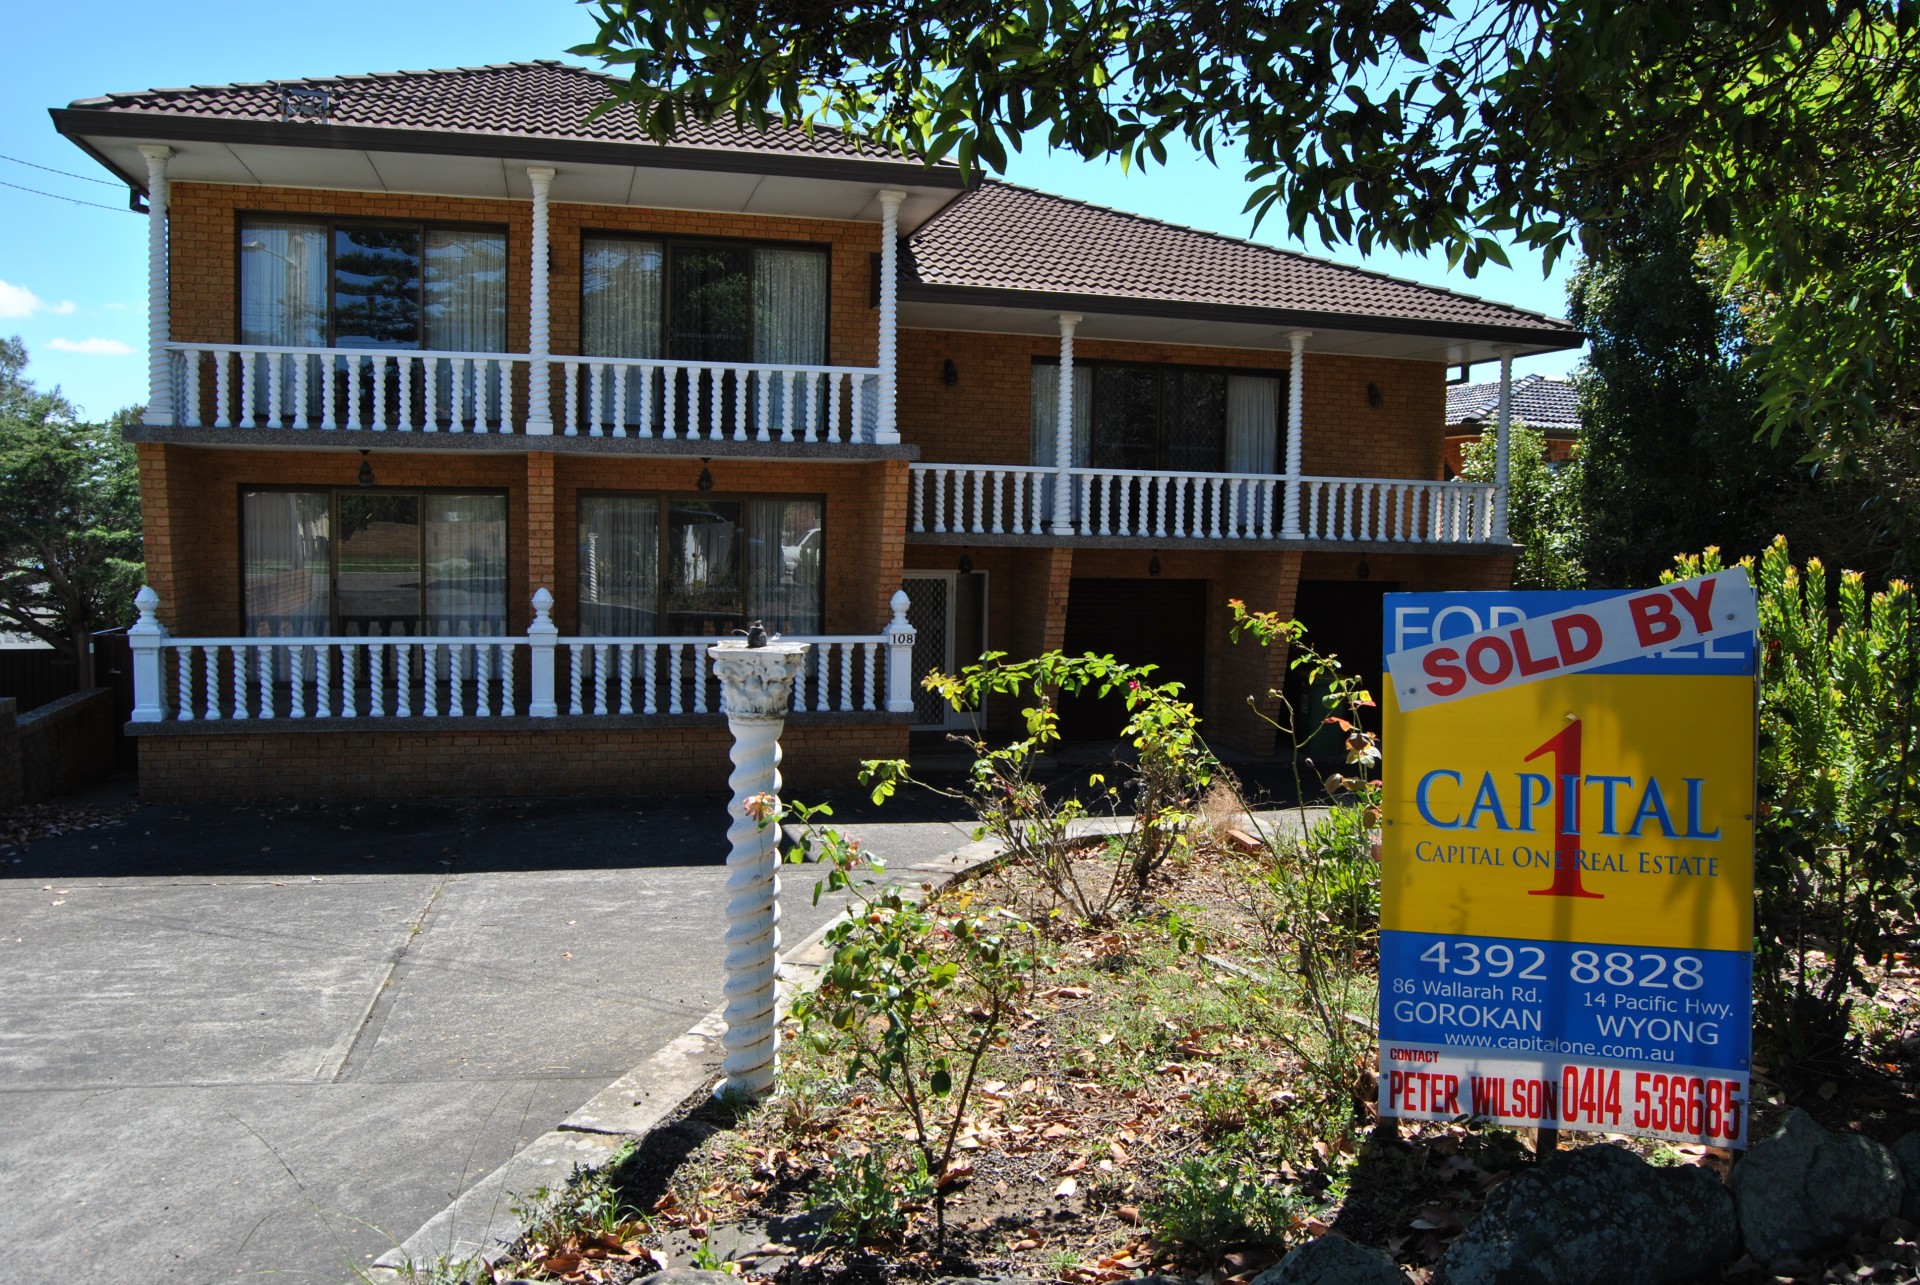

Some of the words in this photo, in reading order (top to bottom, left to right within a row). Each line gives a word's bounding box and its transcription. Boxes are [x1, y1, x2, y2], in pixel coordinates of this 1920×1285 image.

[892, 634, 914, 644] 108
[1422, 613, 1603, 696] SOLD
[1628, 578, 1716, 648] BY
[1415, 769, 1722, 841] CAPITAL
[1524, 719, 1605, 899] 1
[1420, 941, 1547, 981] 4392
[1570, 950, 1704, 991] 8828
[1393, 978, 1415, 994] 86
[1422, 980, 1504, 1001] Wallarah
[1512, 986, 1542, 1003] Rd.
[1583, 992, 1606, 1008] 14
[1614, 993, 1677, 1013] Pacific
[1685, 999, 1734, 1020] Hwy.
[1393, 1001, 1542, 1032] GOROKAN
[1596, 1013, 1719, 1046] WYONG
[1390, 1048, 1439, 1063] CONTACT
[1445, 1033, 1675, 1062] www.capitalone.com.au
[1389, 1070, 1459, 1115] PETER
[1471, 1076, 1557, 1120] WILSON
[1562, 1065, 1622, 1126] 0414
[1634, 1071, 1741, 1141] 536685
